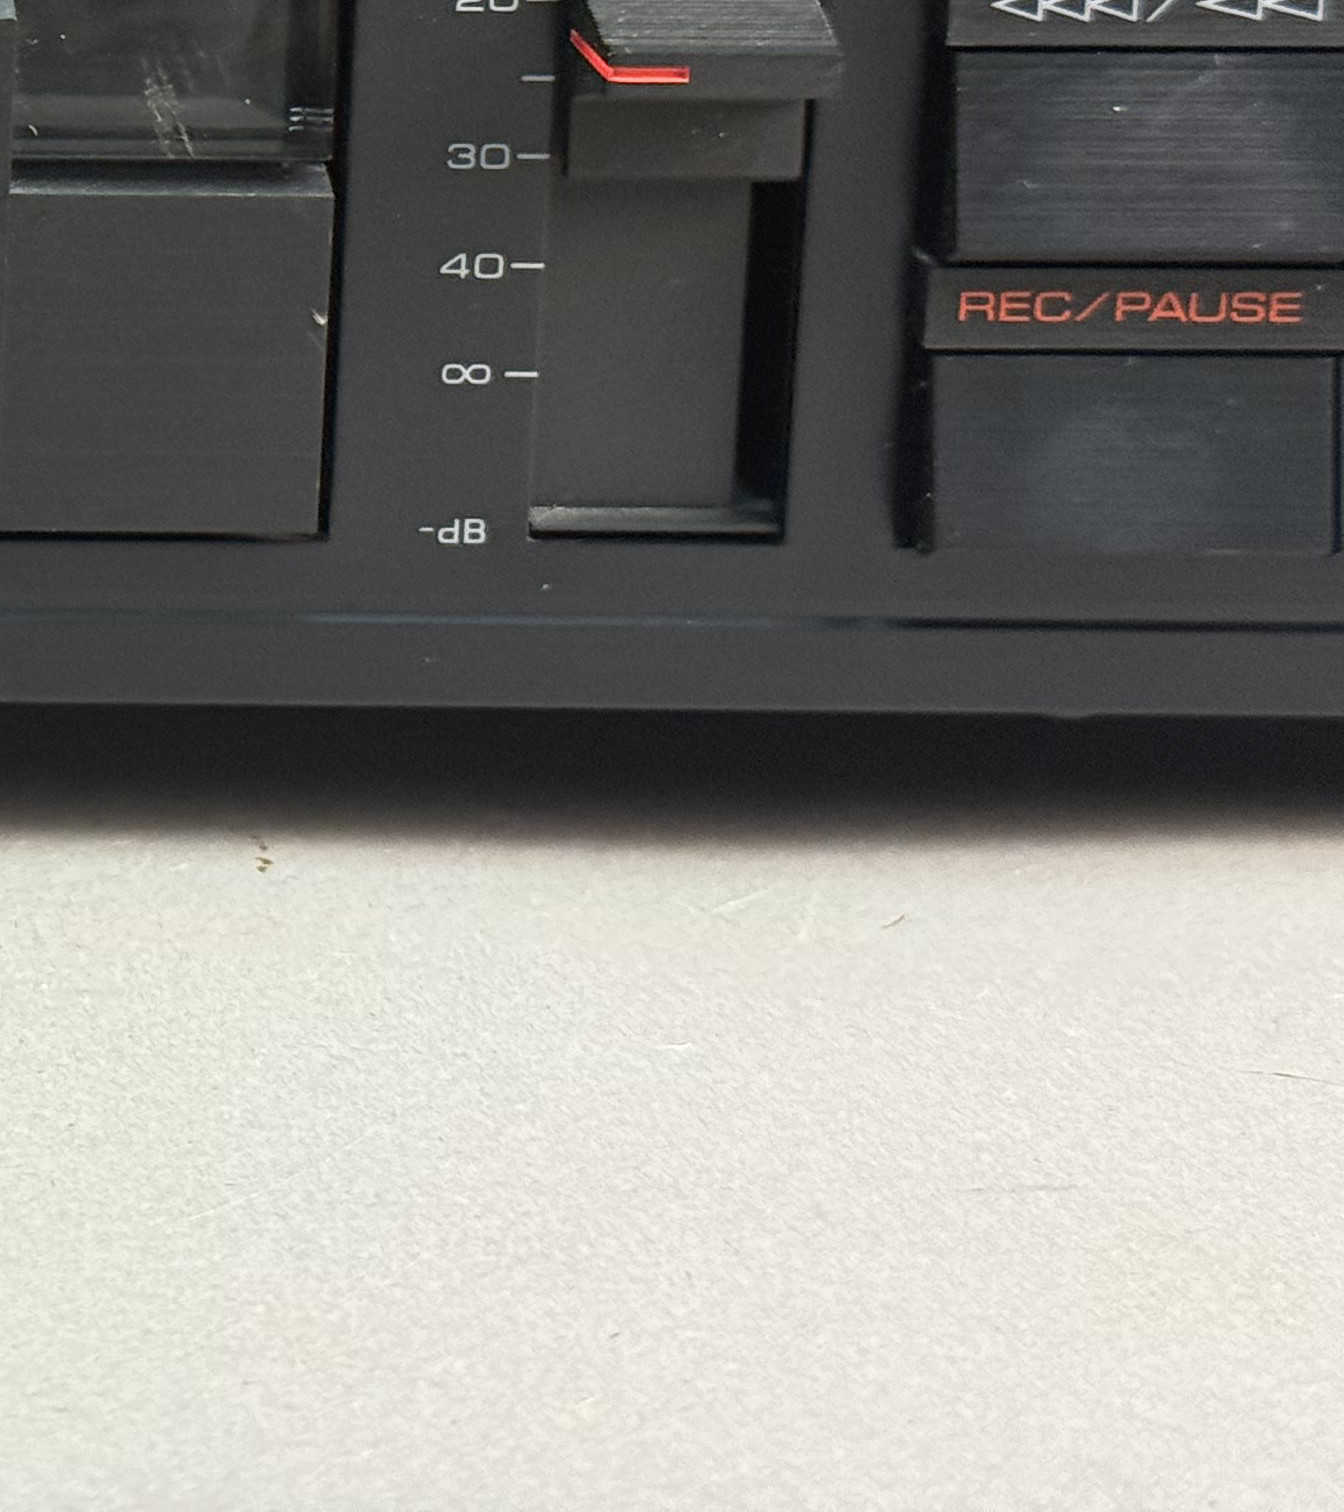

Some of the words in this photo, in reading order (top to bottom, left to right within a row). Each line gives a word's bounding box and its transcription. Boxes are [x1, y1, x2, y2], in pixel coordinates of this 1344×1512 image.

[446, 143, 511, 170] 30
[439, 252, 505, 280] 40
[958, 291, 1303, 324] REC/PAUSE
